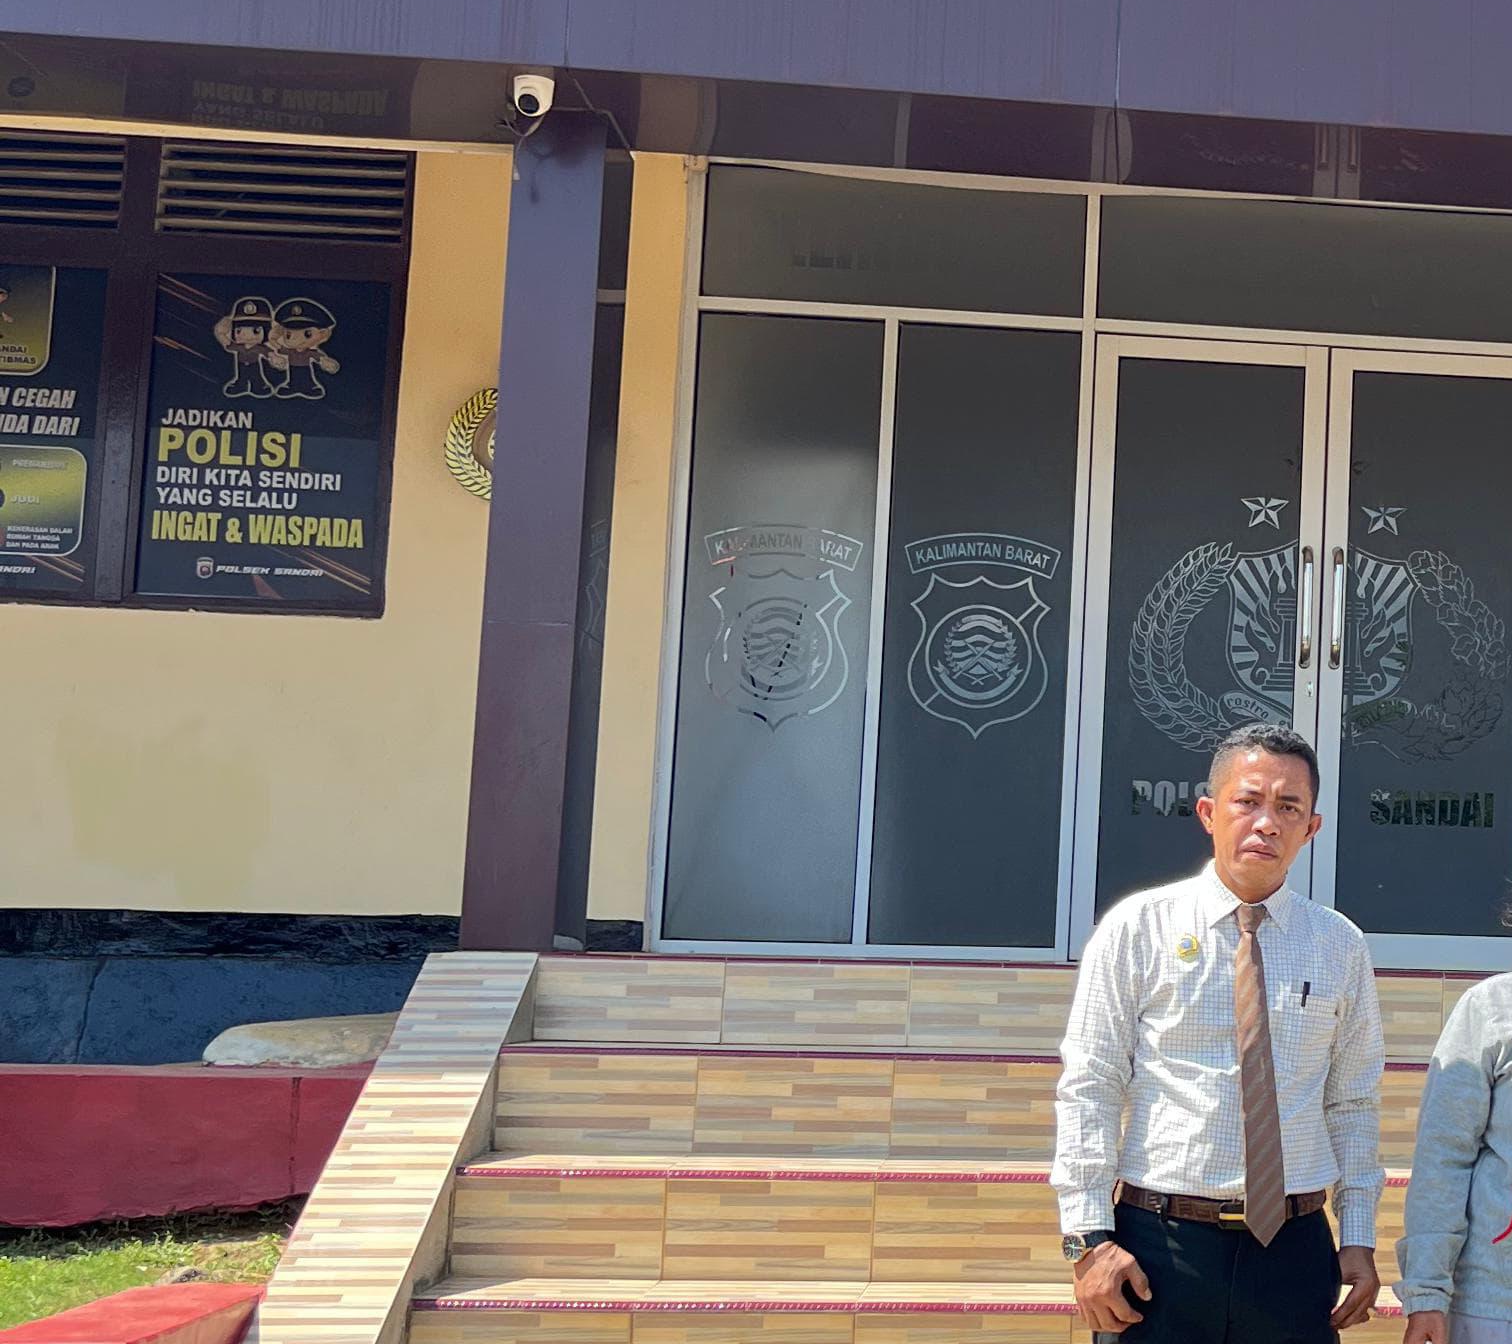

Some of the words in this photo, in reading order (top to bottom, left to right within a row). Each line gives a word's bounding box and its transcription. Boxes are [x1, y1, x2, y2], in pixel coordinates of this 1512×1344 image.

[12, 387, 77, 409] CEGAH
[32, 415, 80, 436] DARI
[161, 408, 253, 429] JADIKAN
[158, 427, 302, 468] POLISI
[156, 466, 198, 485] DIRI
[204, 468, 252, 487] KITA
[258, 471, 342, 491] SENDIRI
[155, 487, 213, 506] YANG
[218, 490, 298, 510] SELALU
[151, 510, 223, 542] INGAT
[225, 517, 243, 543] &
[248, 514, 364, 548] WASPADA
[915, 542, 1001, 565] KALIMANTAN
[1005, 545, 1051, 569] BARAT
[216, 565, 270, 574] POLSEK
[1369, 788, 1494, 828] SANDAI
